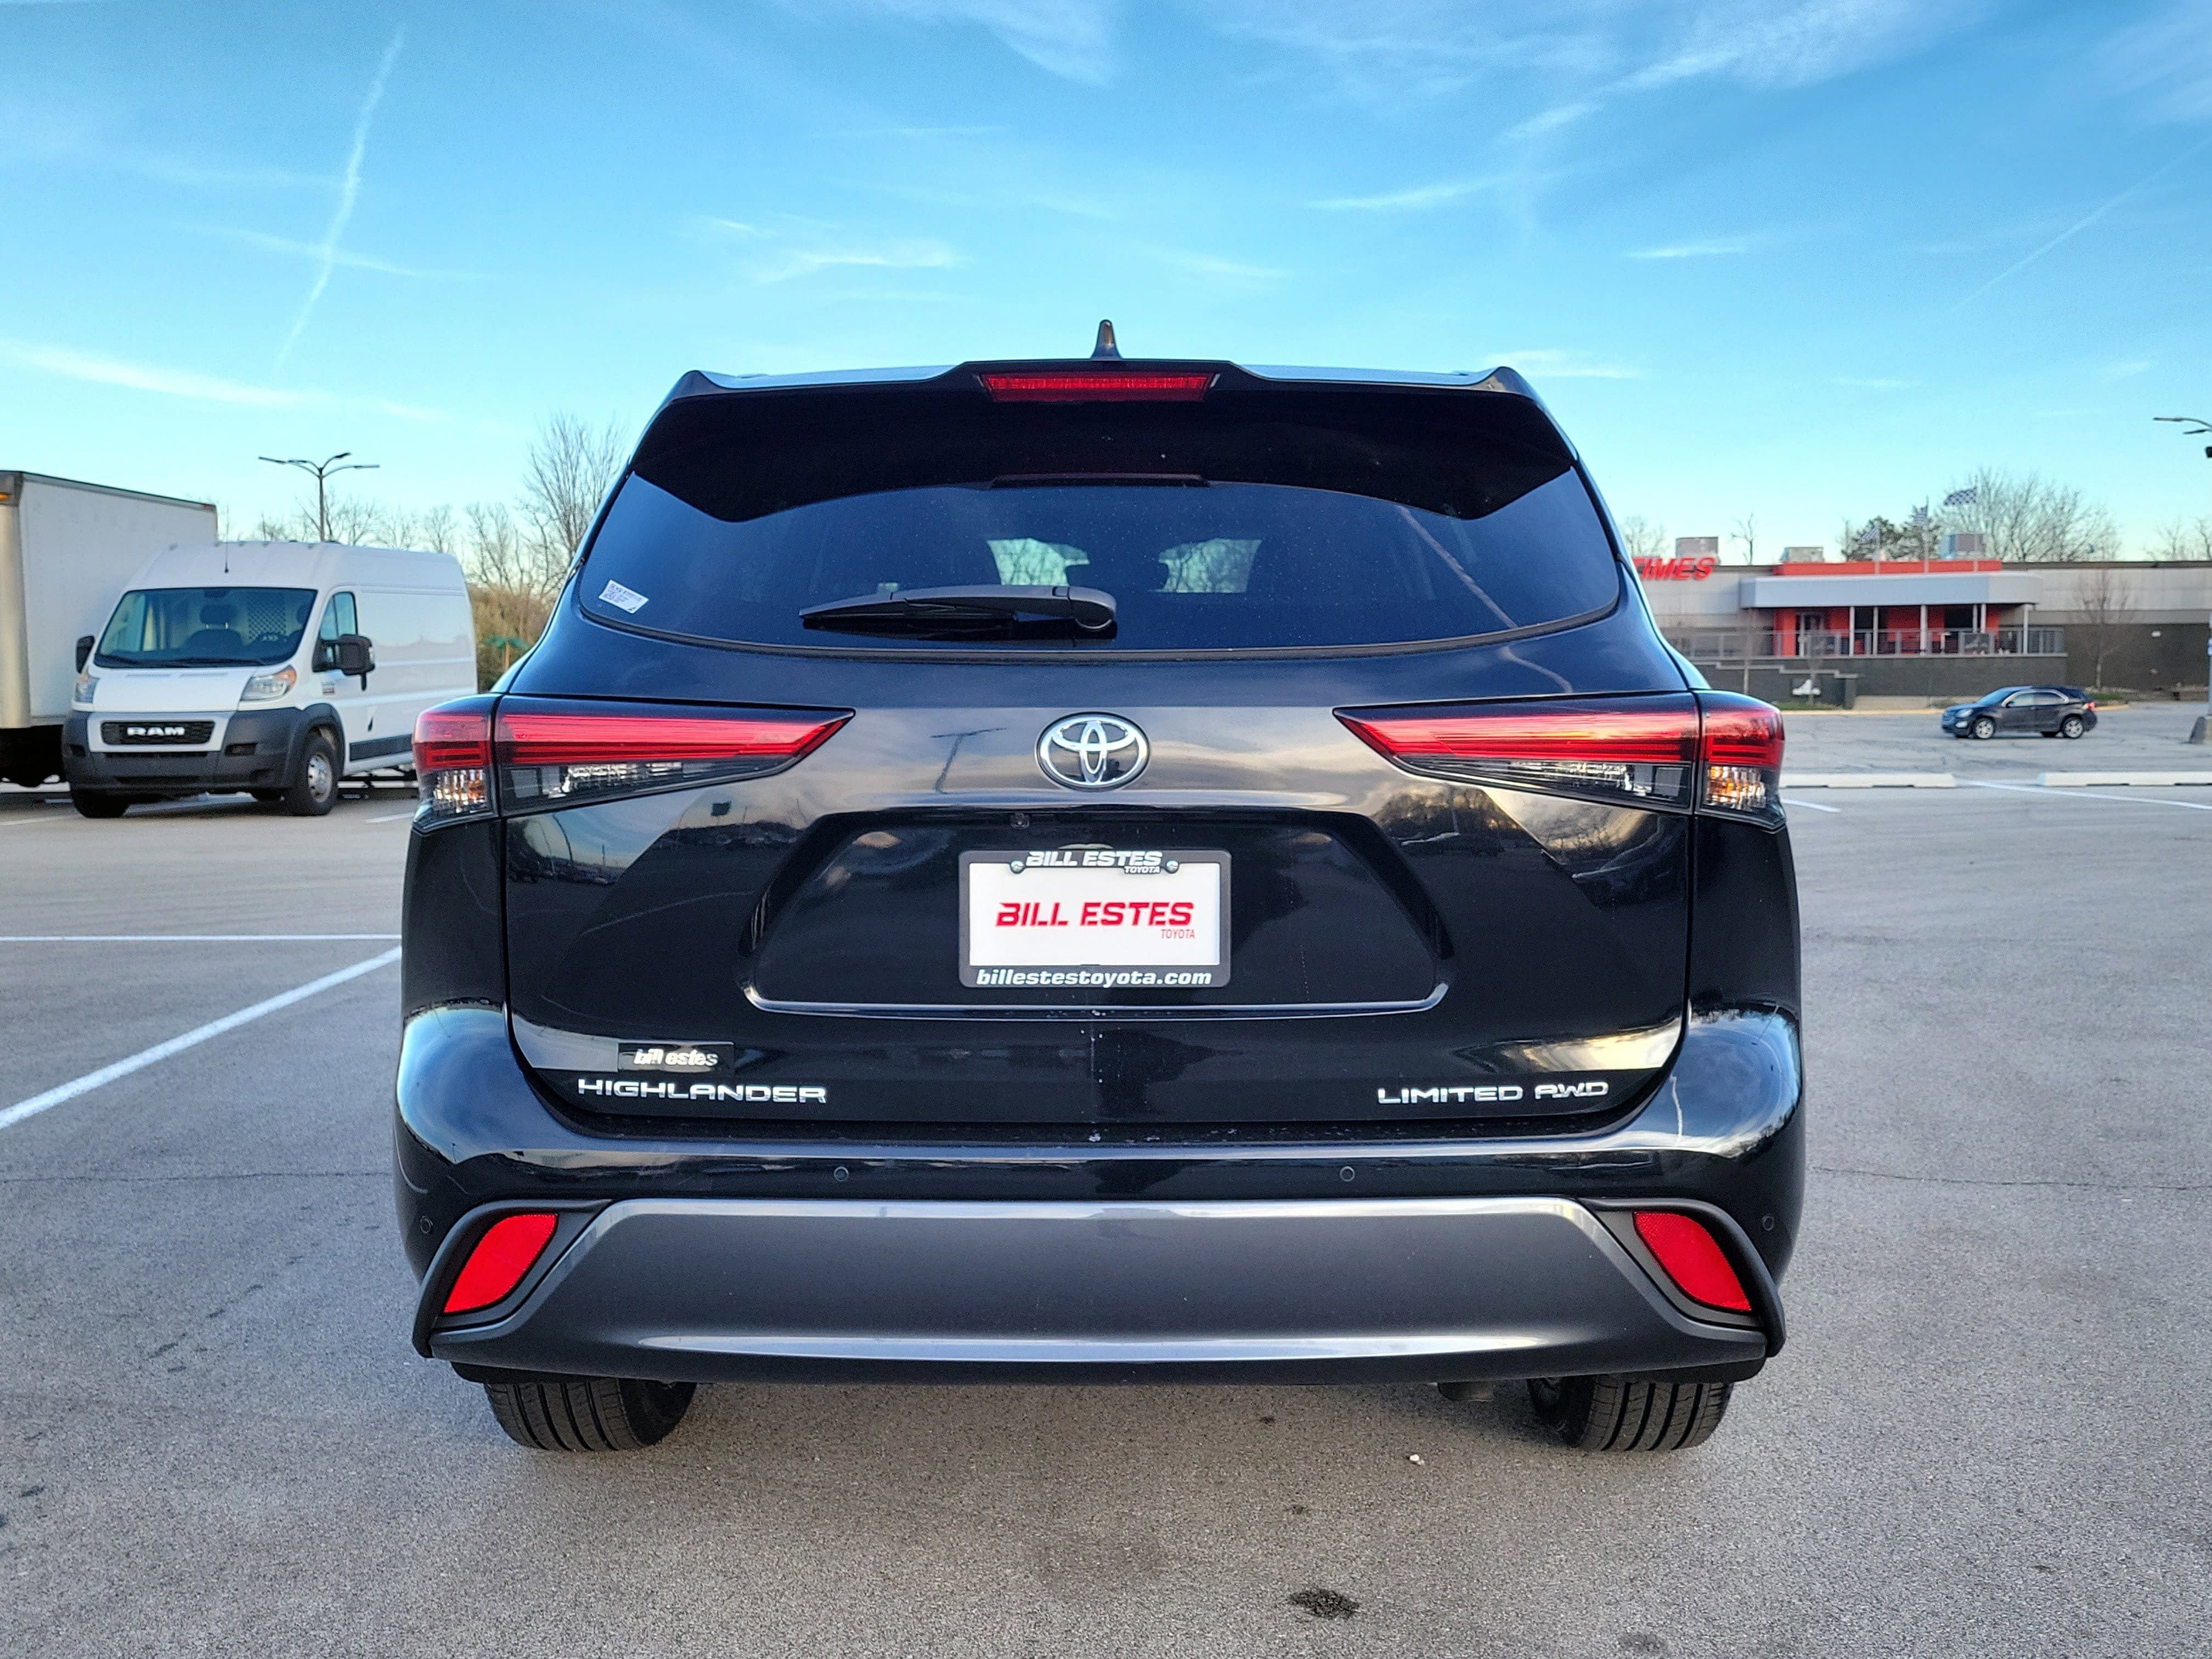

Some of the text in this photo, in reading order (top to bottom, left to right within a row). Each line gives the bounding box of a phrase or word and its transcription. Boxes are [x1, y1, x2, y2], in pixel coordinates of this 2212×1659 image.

[127, 726, 185, 736] RAM
[1025, 851, 1163, 866] BILL ESTES
[996, 902, 1194, 926] BILL ESTES
[1161, 929, 1195, 939] TOYOTA
[976, 969, 1212, 988] billestestoyota.com
[634, 1048, 719, 1066] bill estes
[578, 1079, 827, 1103] HIGHLANDER
[1378, 1081, 1609, 1104] LIMITED AWD
